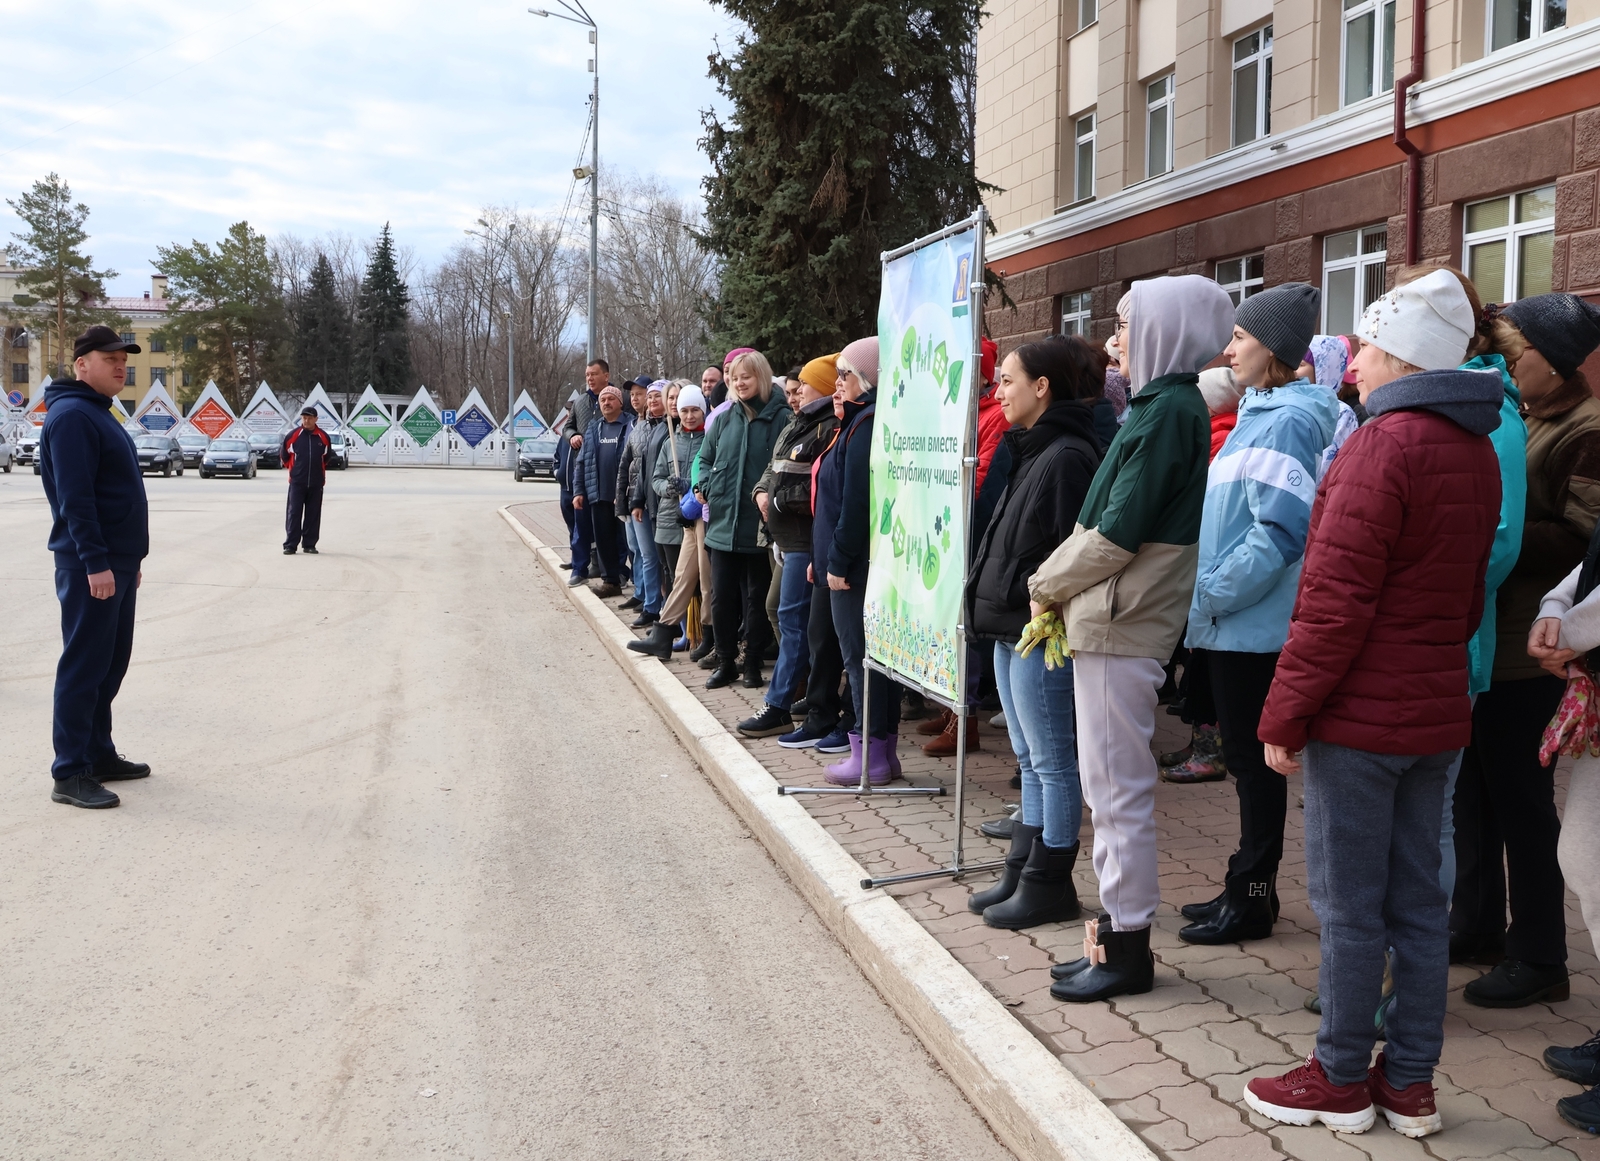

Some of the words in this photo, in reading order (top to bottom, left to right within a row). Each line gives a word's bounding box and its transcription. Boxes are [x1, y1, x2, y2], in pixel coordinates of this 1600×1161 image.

[444, 411, 453, 424] P
[927, 436, 958, 453] вместе
[887, 460, 933, 489] Республику
[933, 463, 961, 491] чище!
